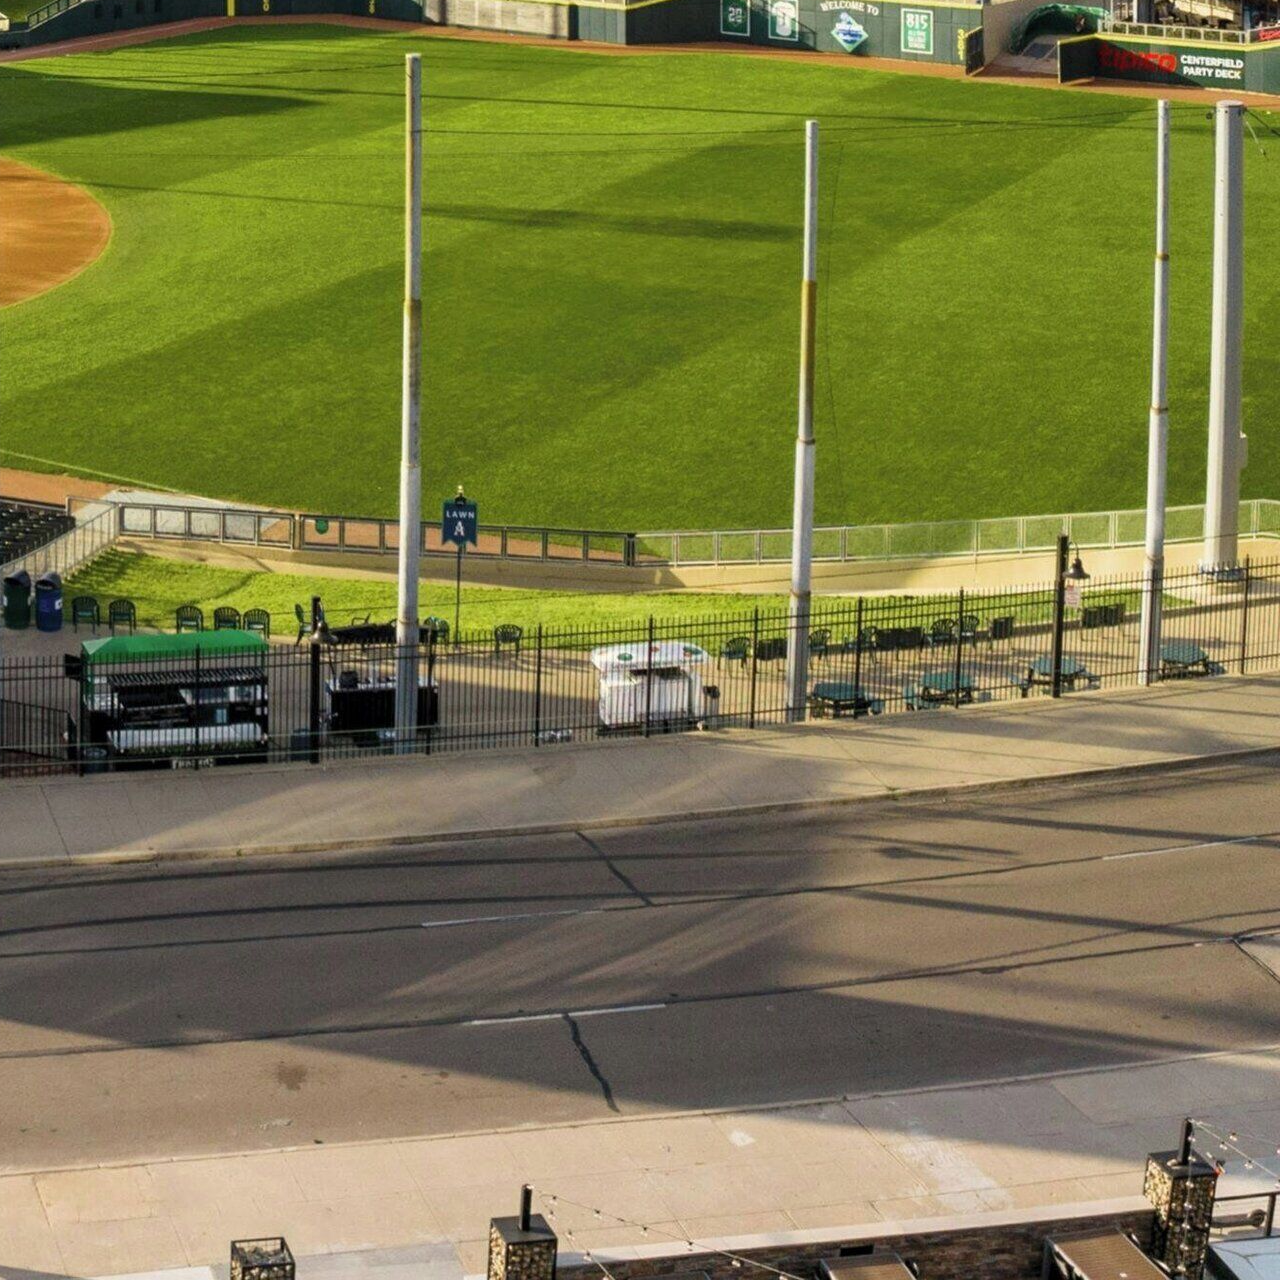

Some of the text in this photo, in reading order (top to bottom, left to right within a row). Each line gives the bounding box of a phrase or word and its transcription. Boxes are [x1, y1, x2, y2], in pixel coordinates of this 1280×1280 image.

[820, 0, 879, 16] WELCOME TO
[906, 13, 928, 30] 815
[1180, 55, 1244, 69] CENTERFIELD
[1183, 66, 1242, 80] PARTY DECK
[446, 510, 475, 519] LAWN
[453, 520, 465, 536] A
